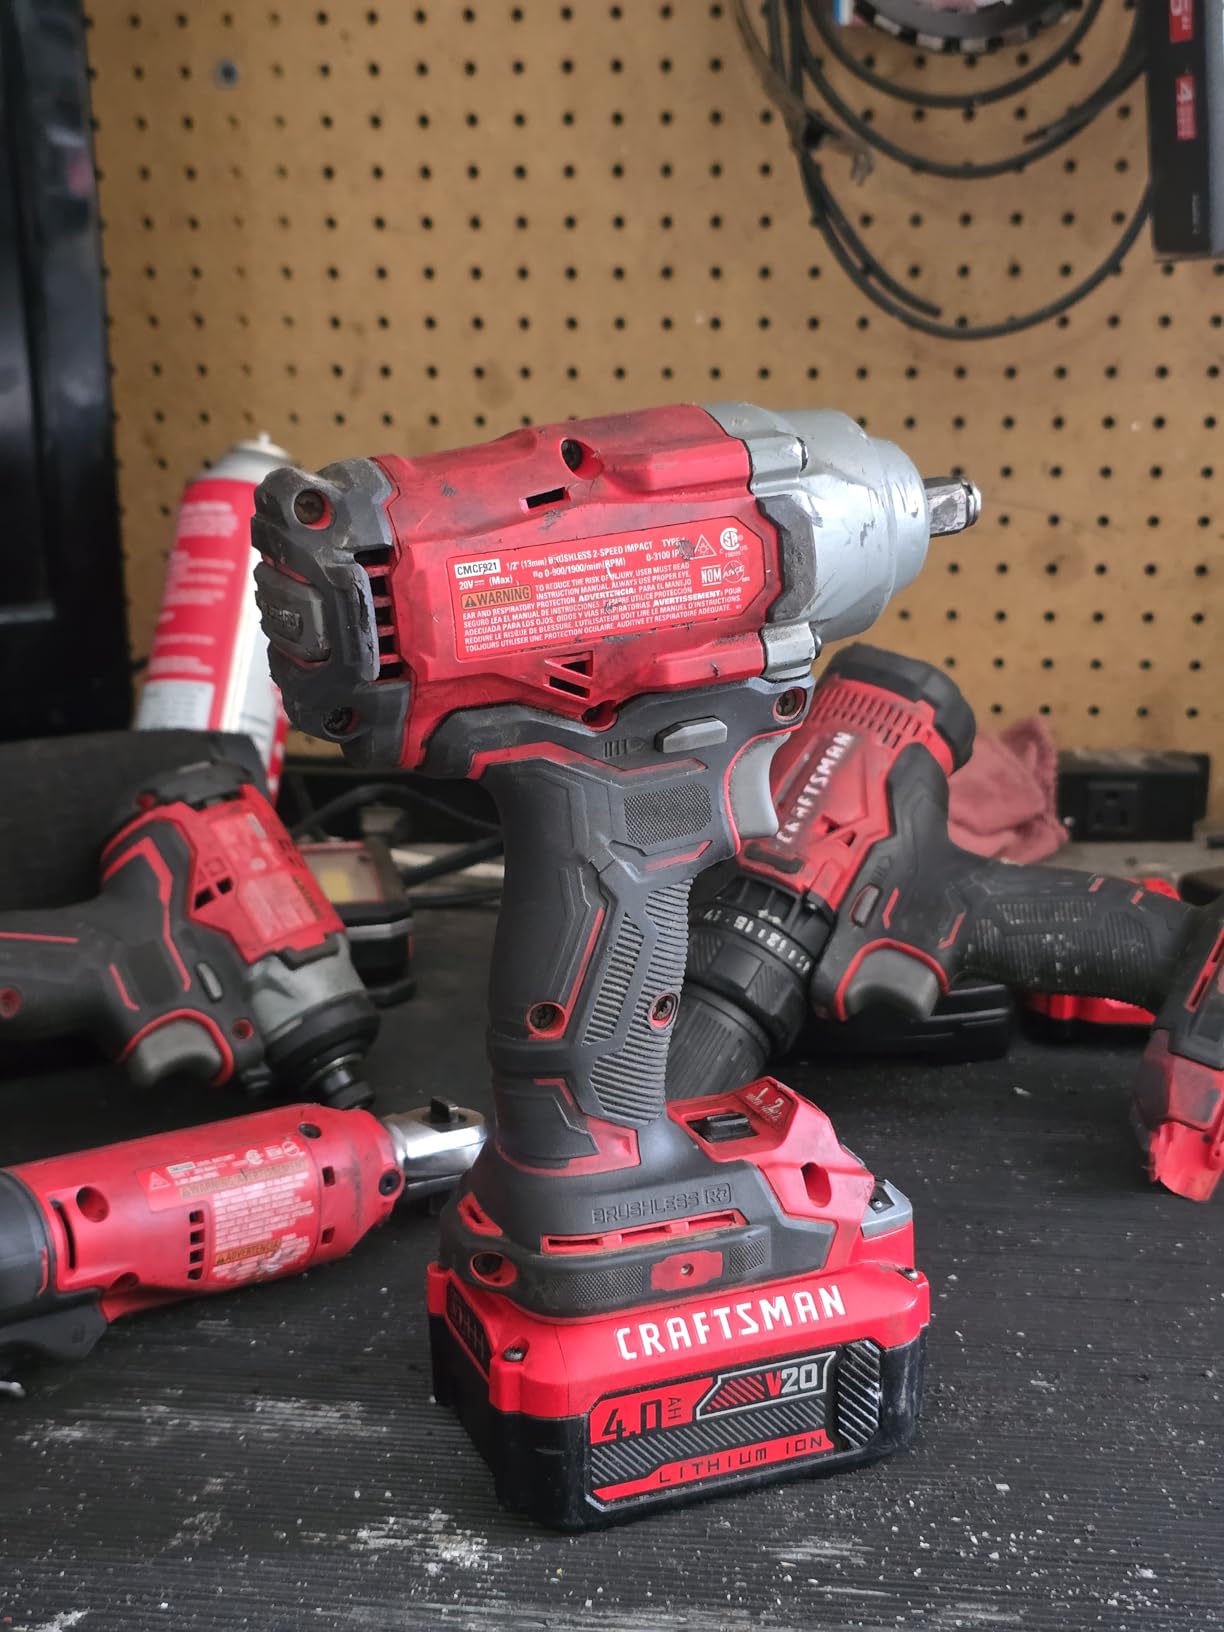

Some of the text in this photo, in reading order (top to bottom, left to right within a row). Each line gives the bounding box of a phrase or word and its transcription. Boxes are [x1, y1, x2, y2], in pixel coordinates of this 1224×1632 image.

[624, 540, 653, 555] IMPACT
[457, 561, 498, 576] CMCF921
[546, 580, 570, 590] REDUCE
[653, 565, 672, 574] MUST
[673, 562, 689, 571] READ
[489, 574, 513, 587] (Max)
[477, 587, 530, 605] WARNING
[537, 587, 579, 600] INSTRUCTION
[463, 612, 475, 620] EAR
[477, 610, 491, 618] AND
[591, 1191, 699, 1225] BRUSHLESS
[616, 1285, 846, 1360] CRAFTSMAN
[765, 1363, 818, 1397] V20
[659, 1435, 822, 1484] LITHIUM ION
